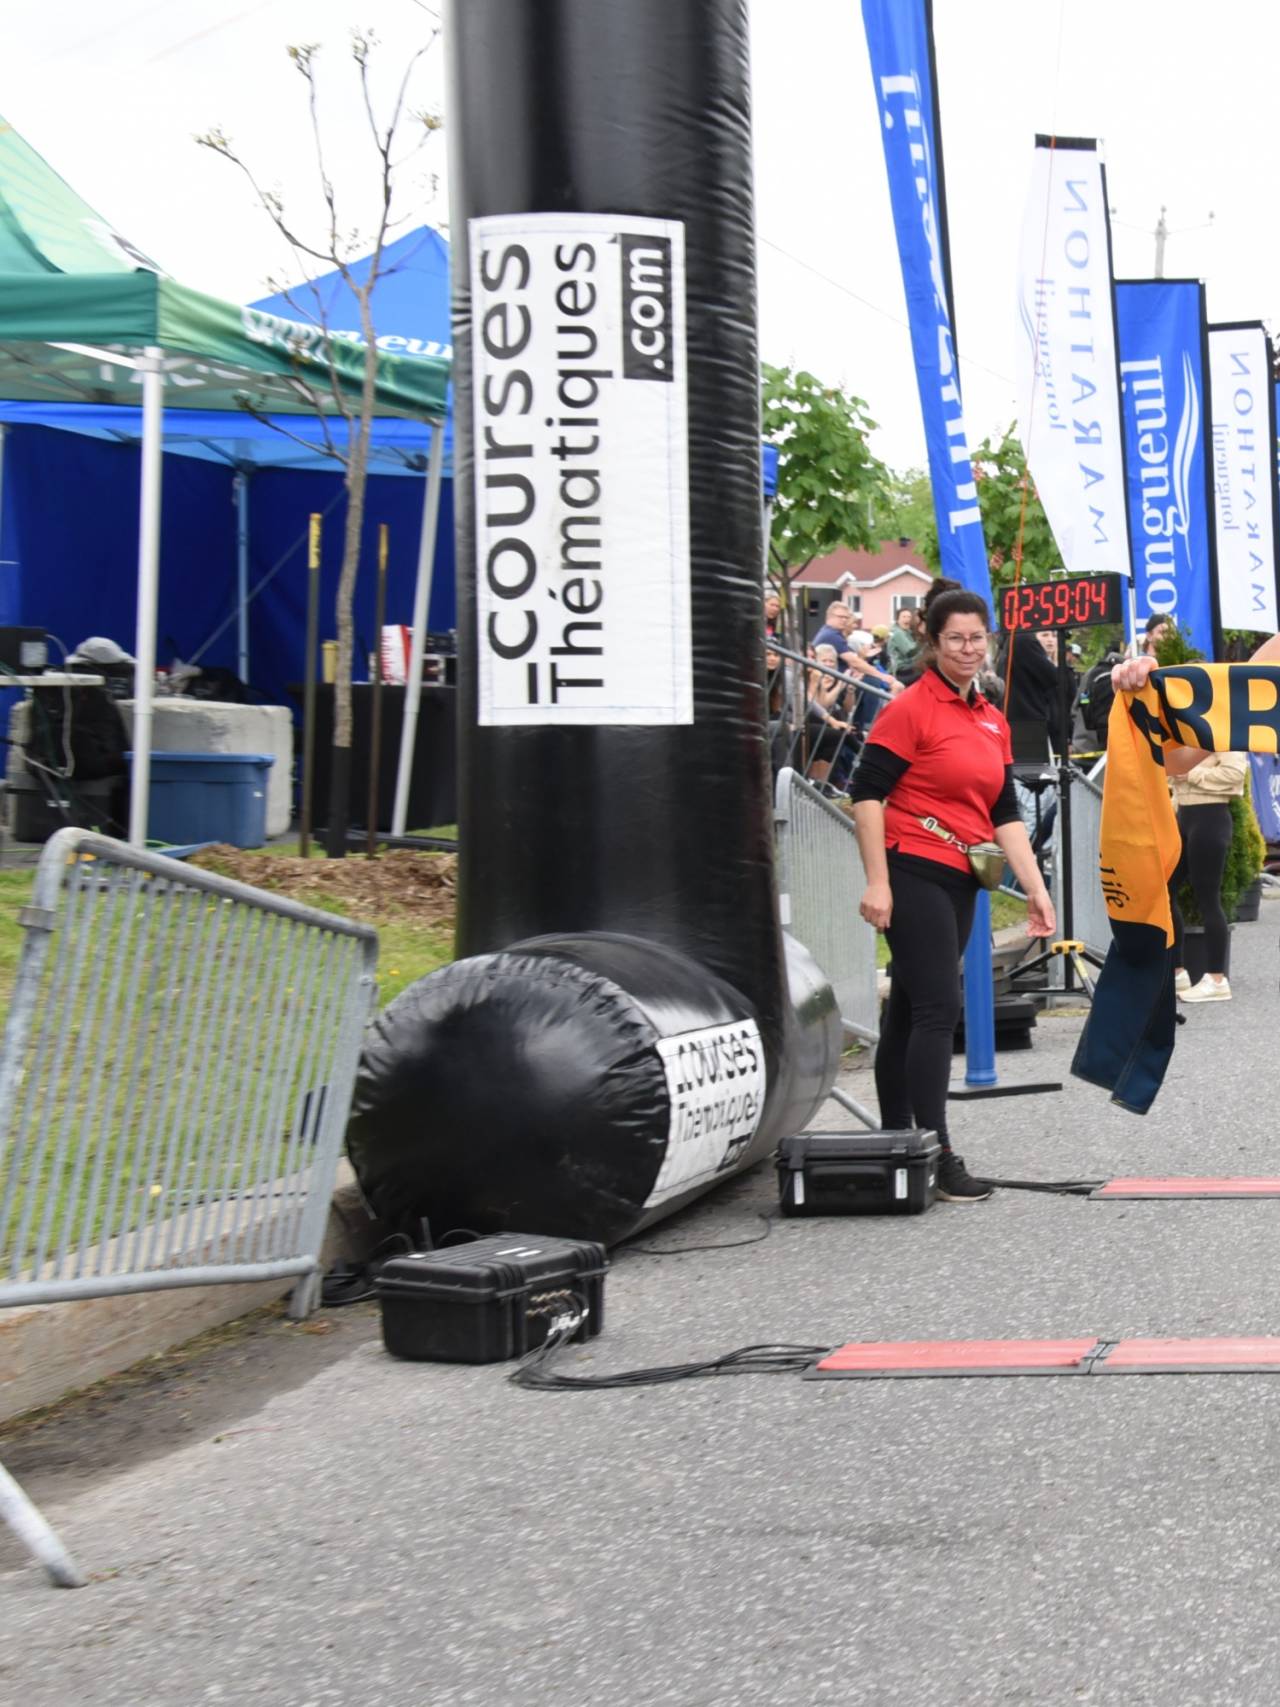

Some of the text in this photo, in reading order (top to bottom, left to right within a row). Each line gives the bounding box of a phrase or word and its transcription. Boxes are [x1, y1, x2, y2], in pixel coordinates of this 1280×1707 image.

[629, 247, 665, 370] .com
[545, 242, 613, 704] Thématiques
[1004, 580, 1107, 630] 02:59:04
